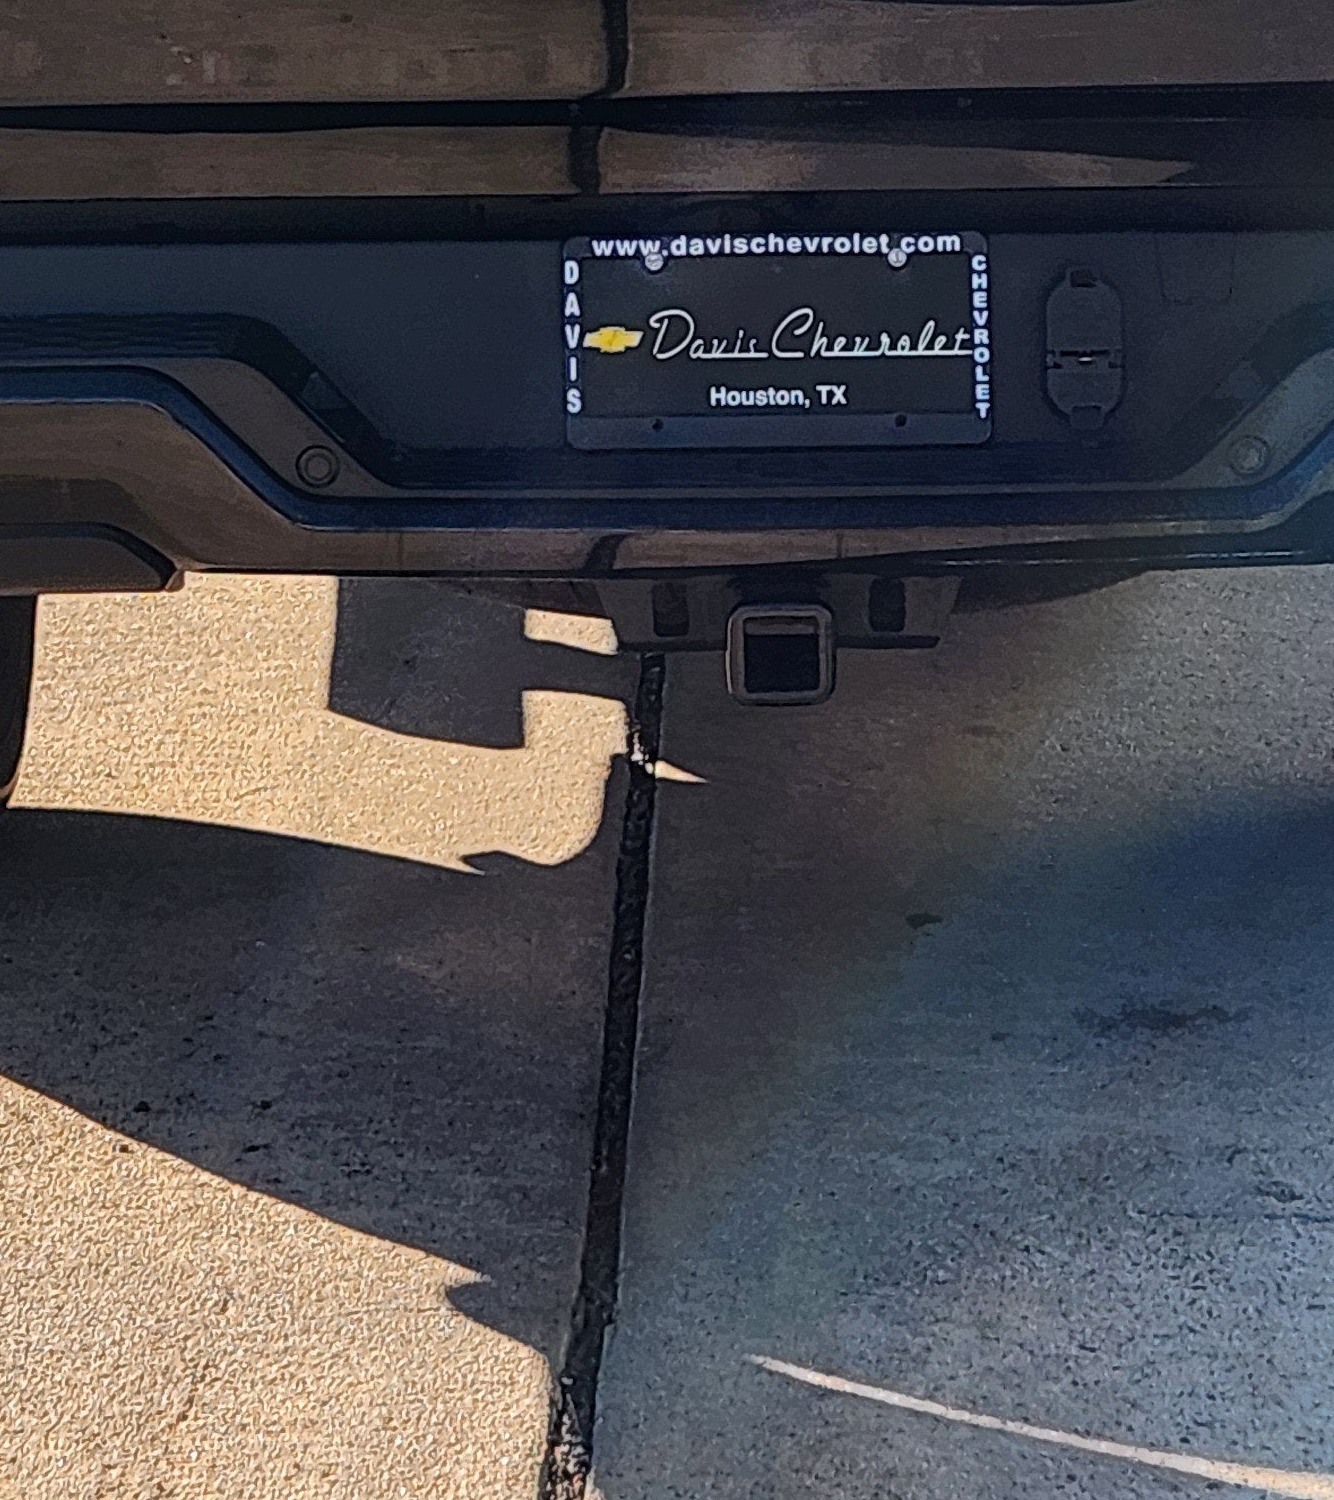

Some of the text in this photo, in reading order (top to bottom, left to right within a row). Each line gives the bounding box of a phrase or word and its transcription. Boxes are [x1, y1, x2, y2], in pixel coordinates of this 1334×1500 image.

[591, 232, 962, 257] www.davischevroletcom
[564, 260, 581, 414] DAVIS
[649, 307, 973, 360] Davis Chevrolet
[971, 254, 991, 419] CHEVROLET
[709, 385, 848, 408] Houston, TX
